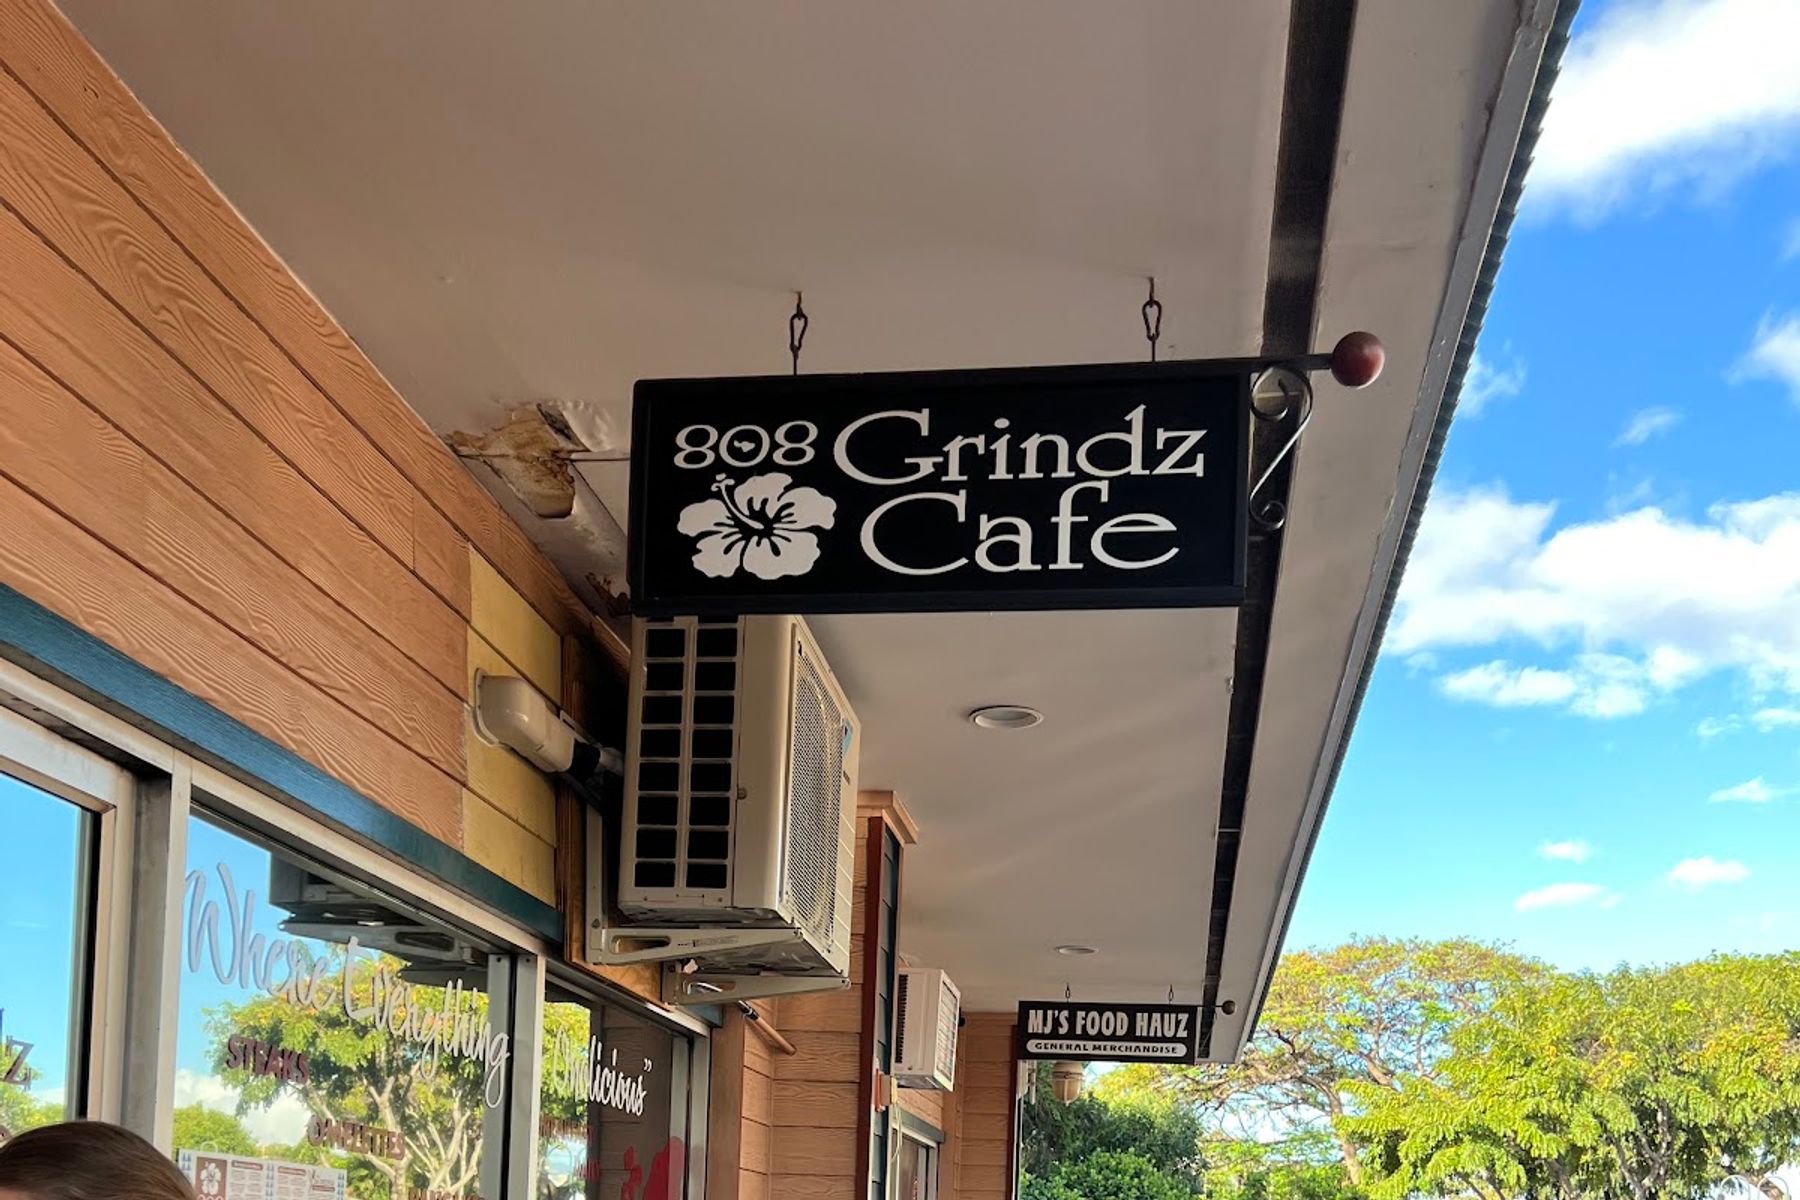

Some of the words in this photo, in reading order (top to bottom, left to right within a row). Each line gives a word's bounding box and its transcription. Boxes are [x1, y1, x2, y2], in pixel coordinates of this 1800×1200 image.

[674, 421, 819, 470] 808
[833, 404, 1208, 486] Grindz
[860, 480, 1180, 576] Cafe
[184, 862, 335, 1012] Where
[343, 935, 511, 1109] Everything
[1028, 1010, 1069, 1034] MJ'S
[1075, 1010, 1129, 1037] FOOD
[1135, 1012, 1189, 1038] HAUZ
[1035, 1042, 1088, 1052] GENERAL
[1092, 1043, 1178, 1054] MERCHANDISE
[226, 1034, 311, 1085] STEAKS
